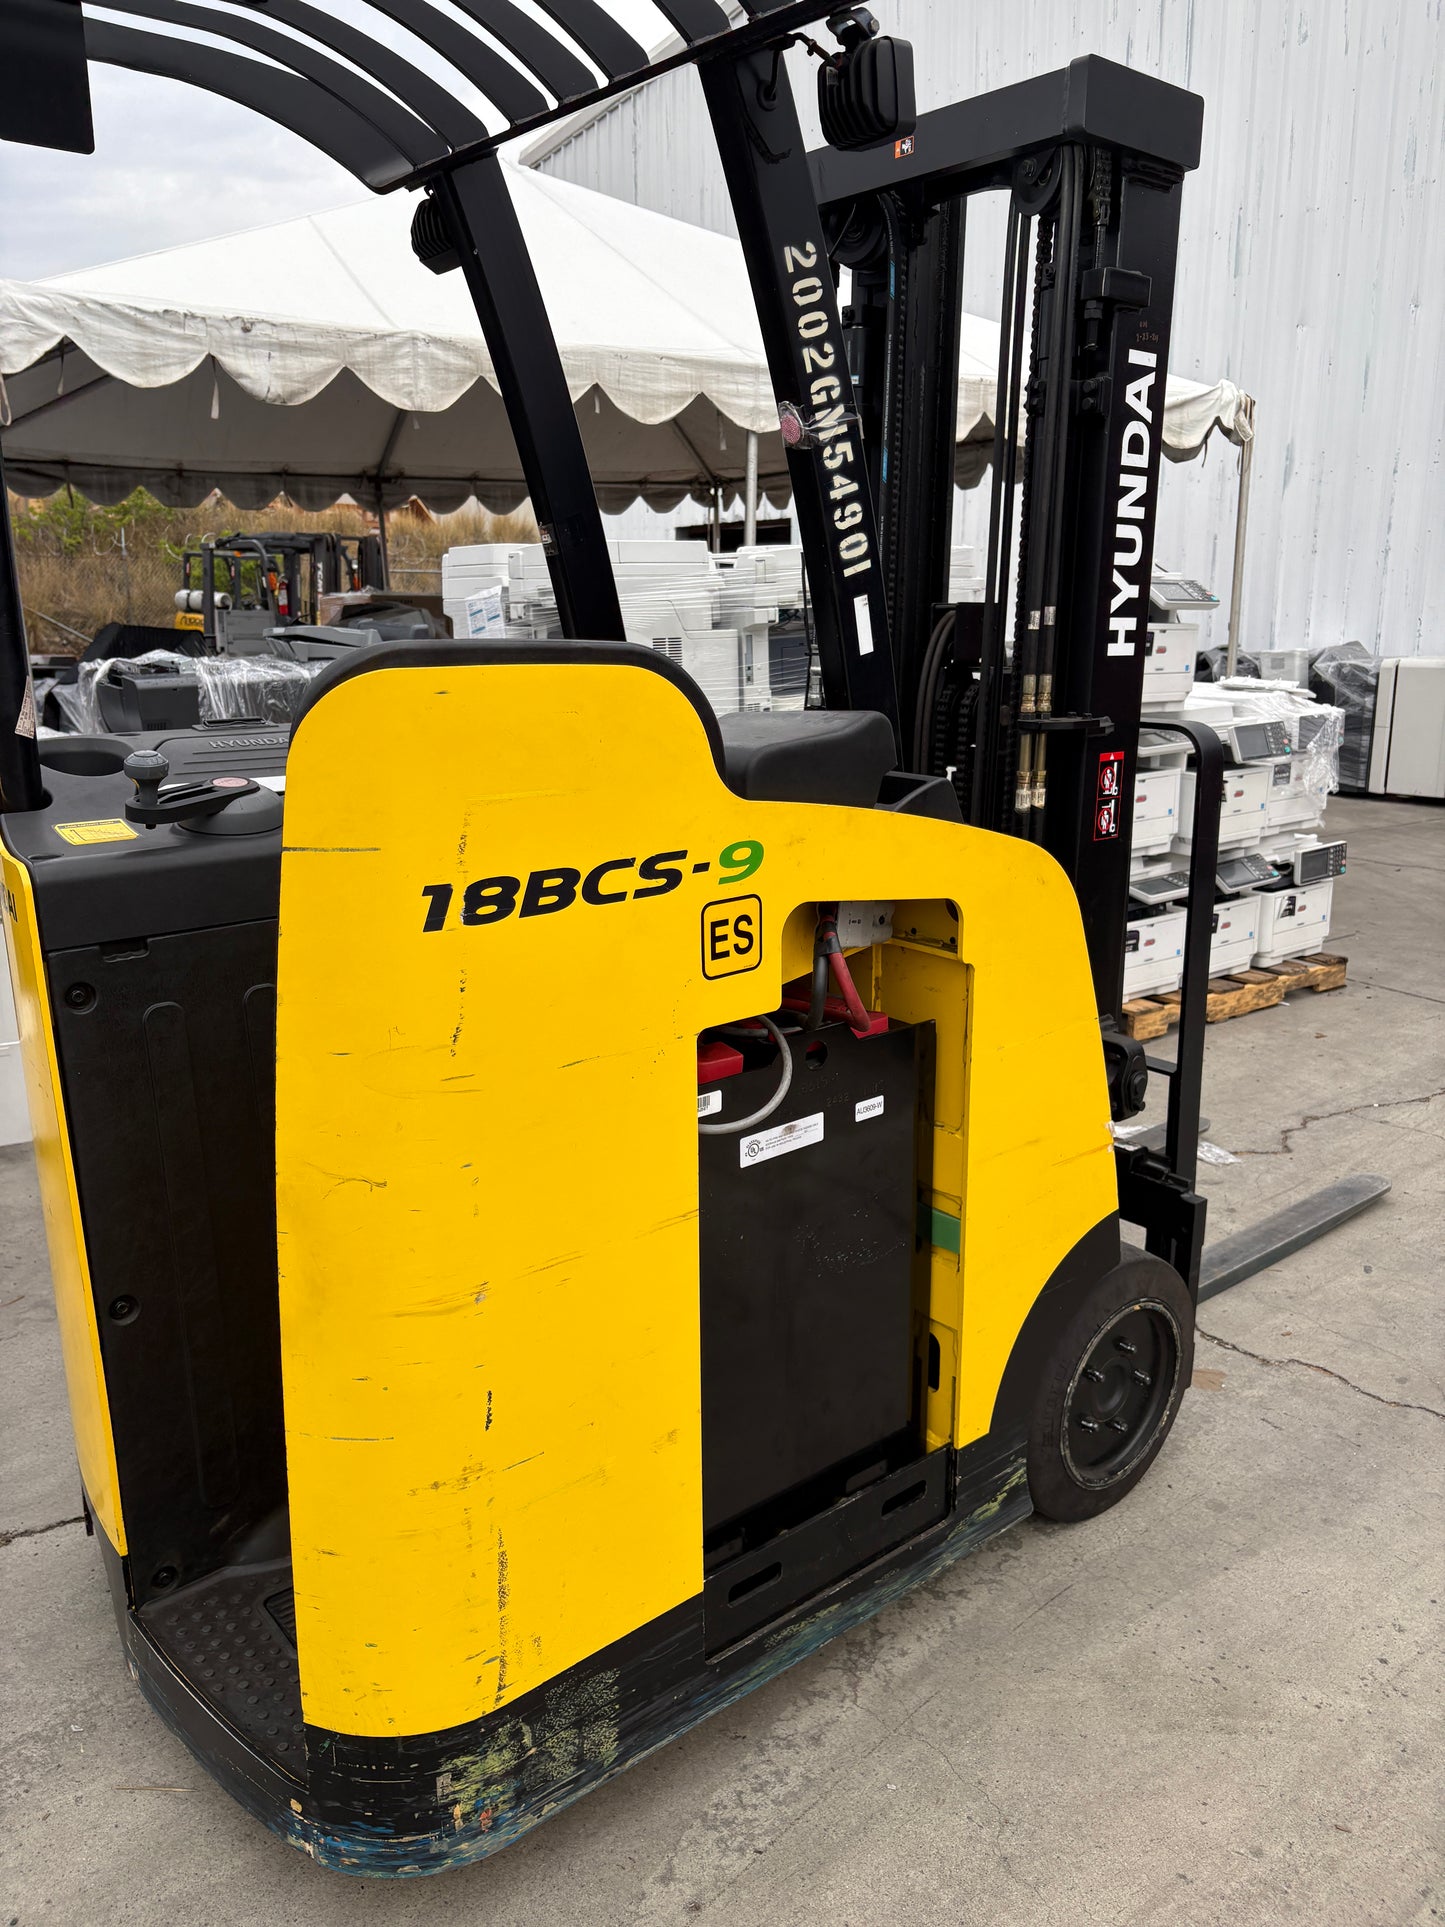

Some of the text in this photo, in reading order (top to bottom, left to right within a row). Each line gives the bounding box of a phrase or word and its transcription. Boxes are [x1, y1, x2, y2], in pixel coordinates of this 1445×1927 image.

[1107, 349, 1158, 657] HYUNDAI
[209, 737, 288, 748] HYUNDA
[422, 841, 764, 933] 18BCS-9
[711, 915, 753, 960] ES
